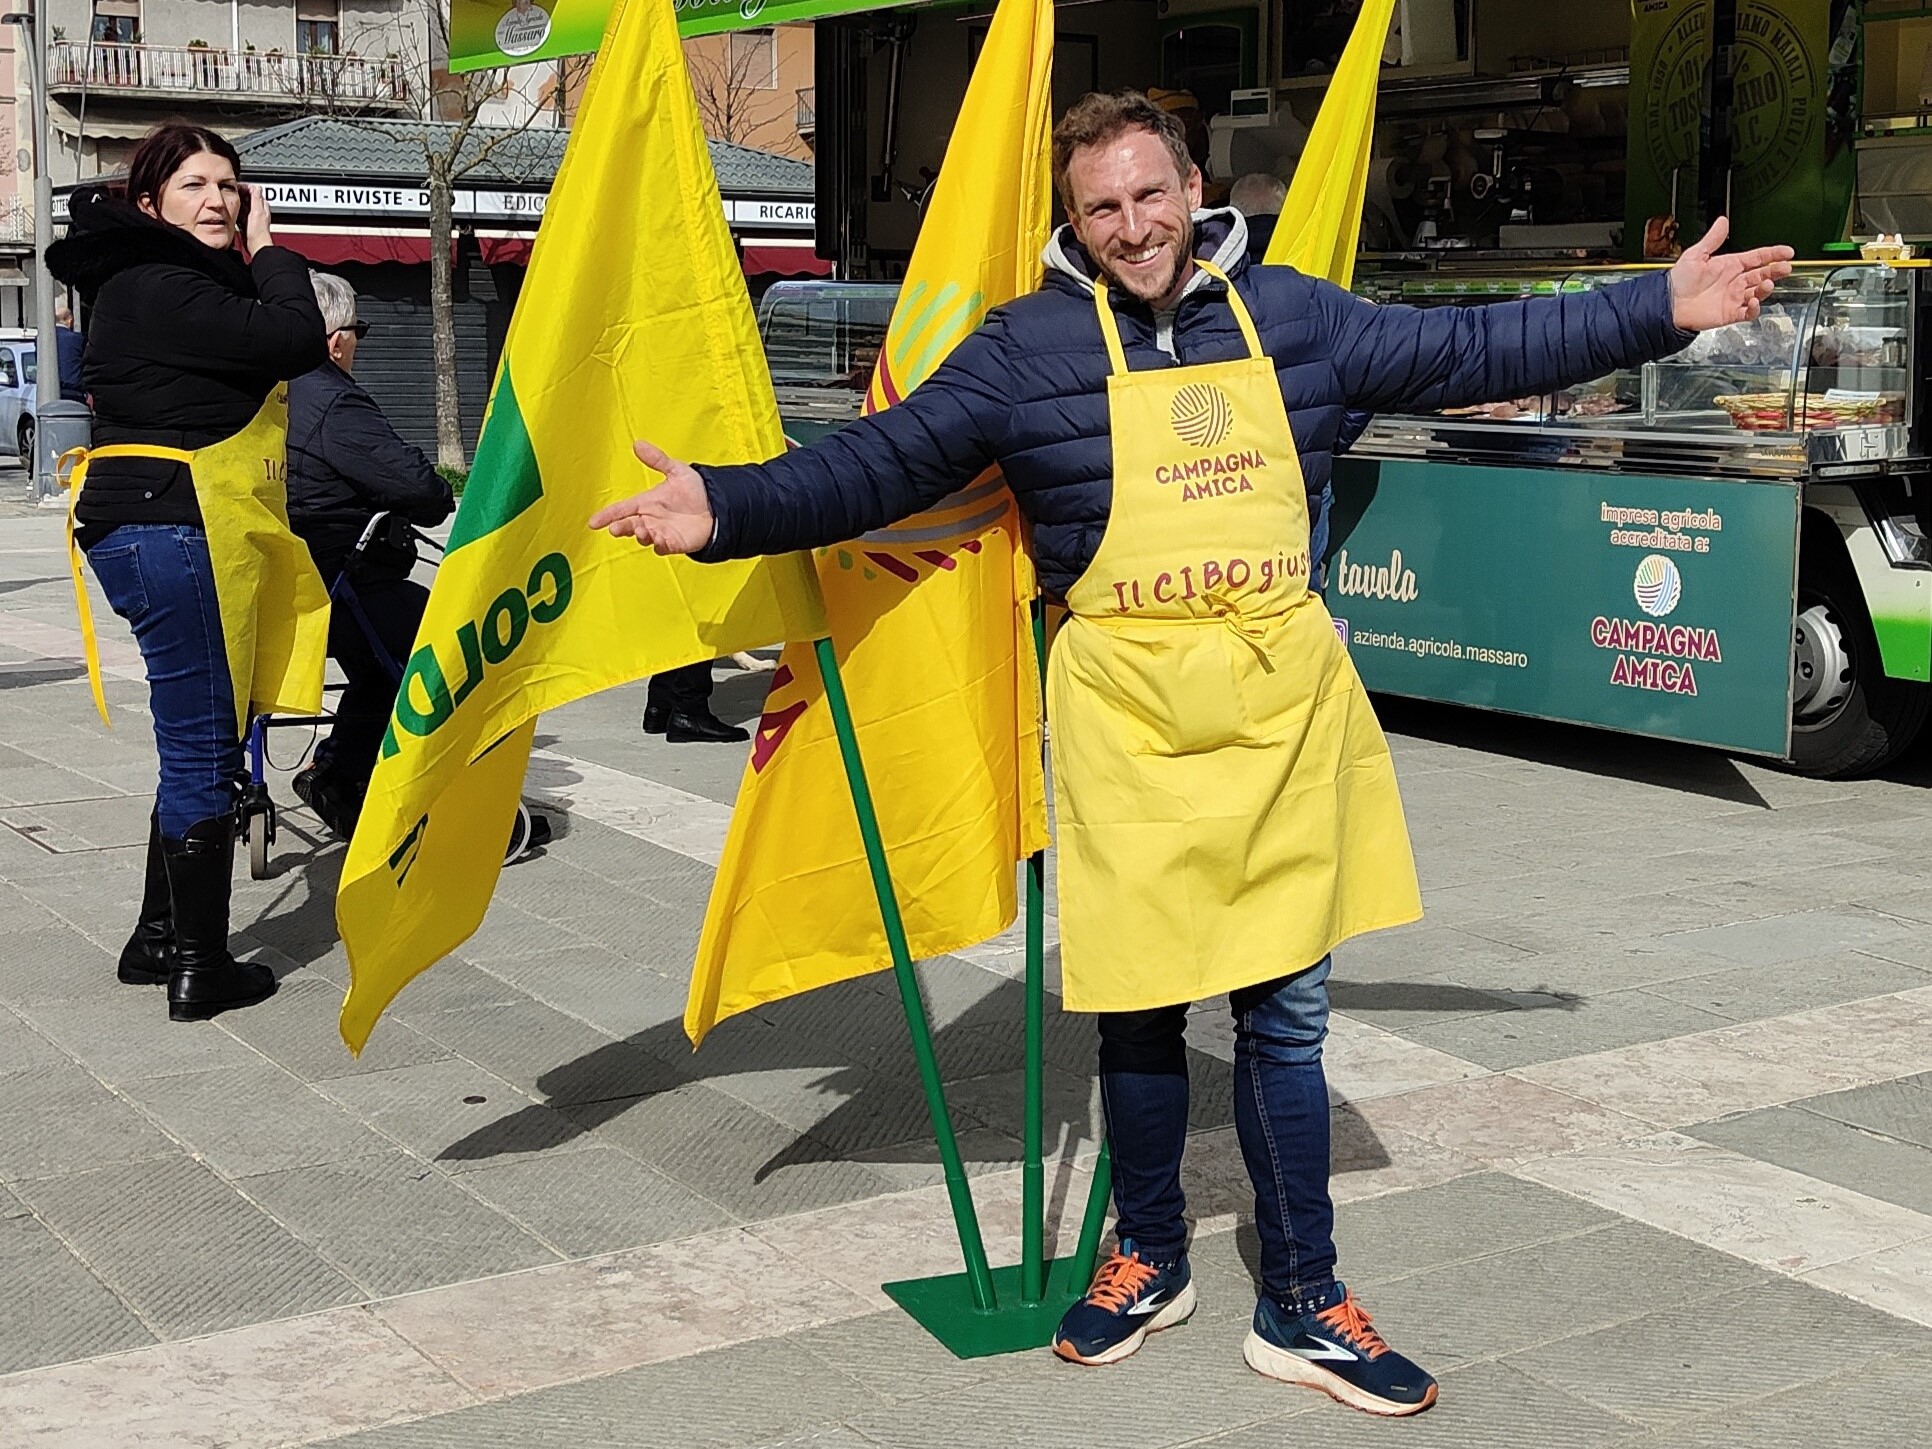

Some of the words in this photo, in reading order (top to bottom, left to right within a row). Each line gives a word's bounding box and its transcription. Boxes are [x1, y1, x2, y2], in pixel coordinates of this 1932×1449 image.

[502, 25, 546, 45] Massaro
[334, 190, 403, 206] RIVISTE
[1155, 449, 1268, 484] CAMPAGNA
[1181, 474, 1254, 502] AMICA
[1601, 501, 1659, 528] impresa
[1661, 507, 1722, 532] agricola
[1610, 527, 1693, 551] accreditata
[1694, 536, 1710, 553] a:
[1153, 558, 1251, 604] CIBO
[1338, 549, 1419, 603] tavola
[1353, 628, 1529, 668] azienda.agricola.massaro
[1591, 617, 1722, 662] CAMPAGNA
[1610, 654, 1698, 697] AMICA
